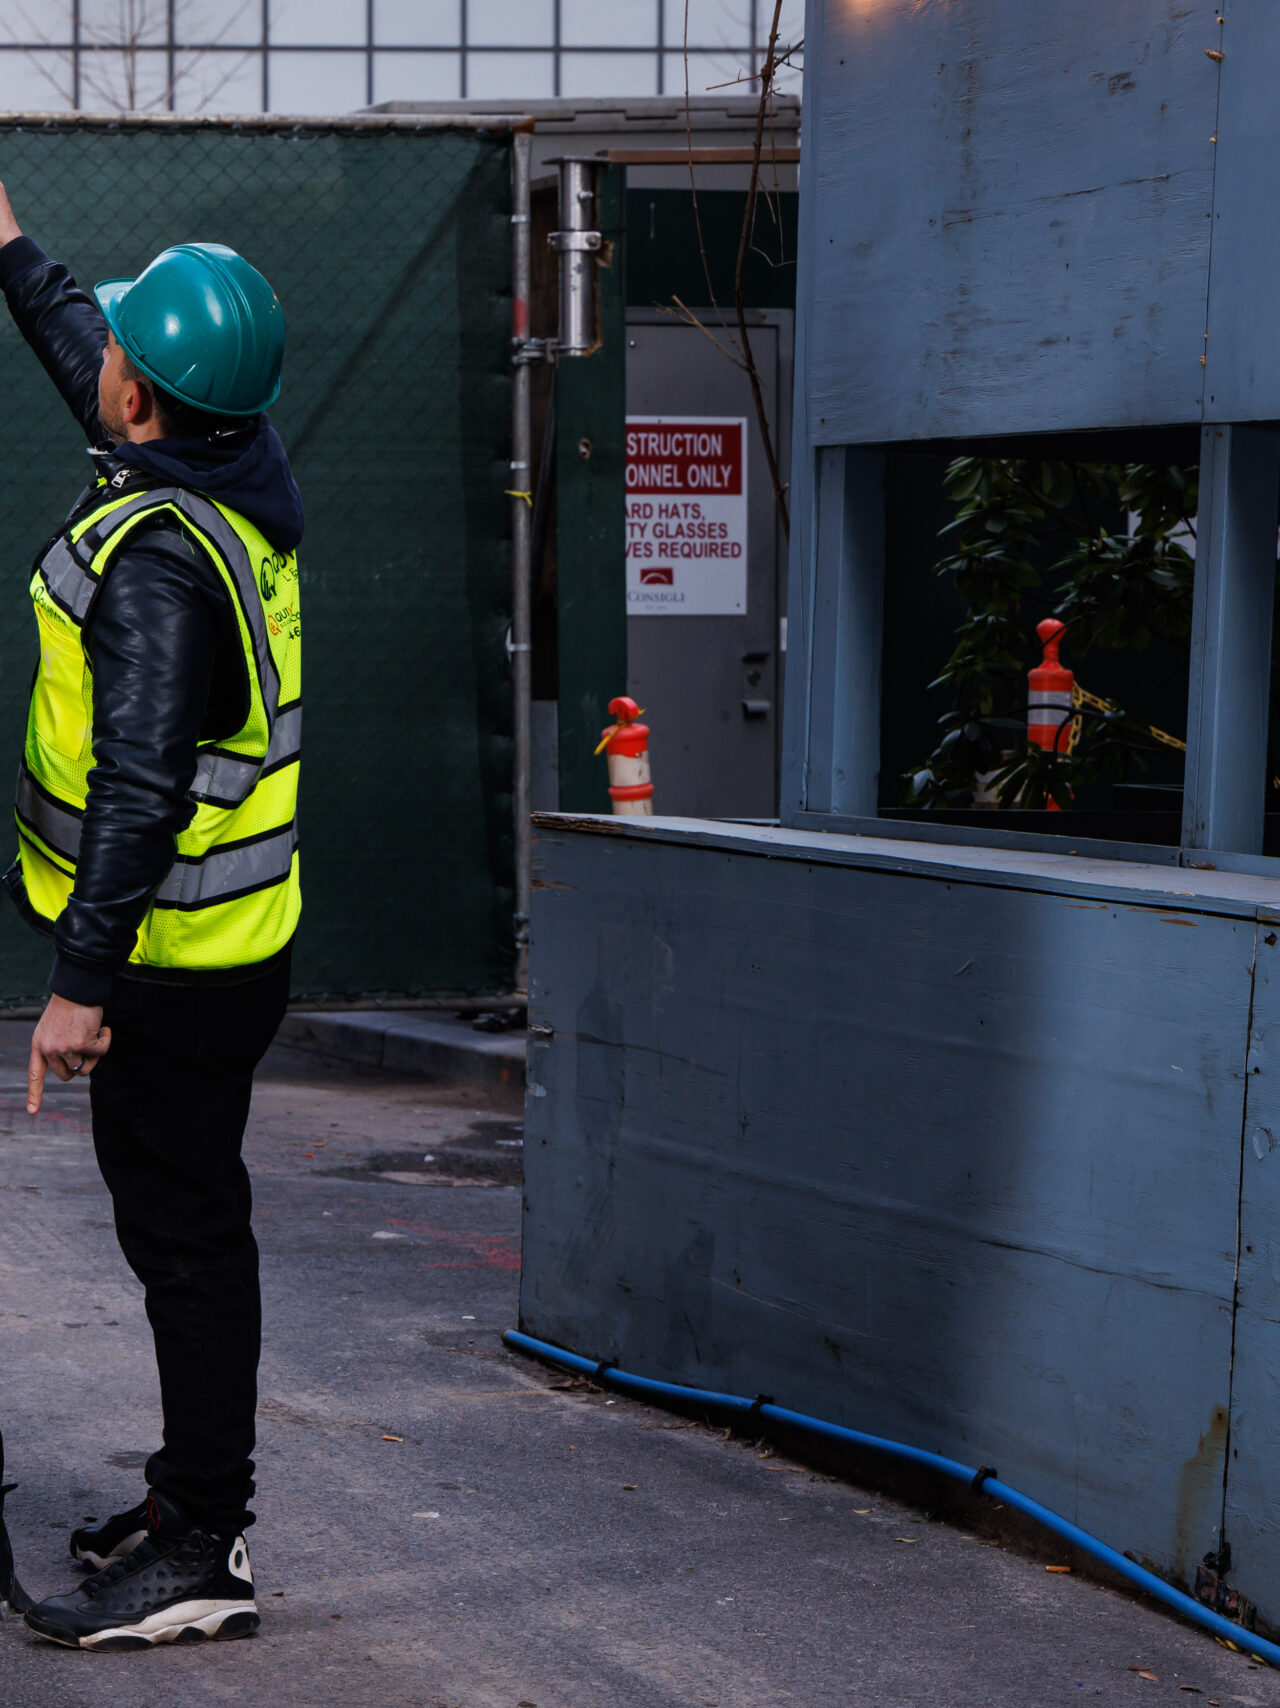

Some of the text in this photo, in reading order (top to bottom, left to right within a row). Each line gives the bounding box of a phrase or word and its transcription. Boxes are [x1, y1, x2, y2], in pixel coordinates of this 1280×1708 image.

[626, 432, 723, 457] STRUCTION
[625, 463, 733, 488] ONNEL ONLY
[658, 502, 706, 521] HATS,
[652, 521, 729, 539] GLASSES
[658, 541, 743, 559] REQUIRED
